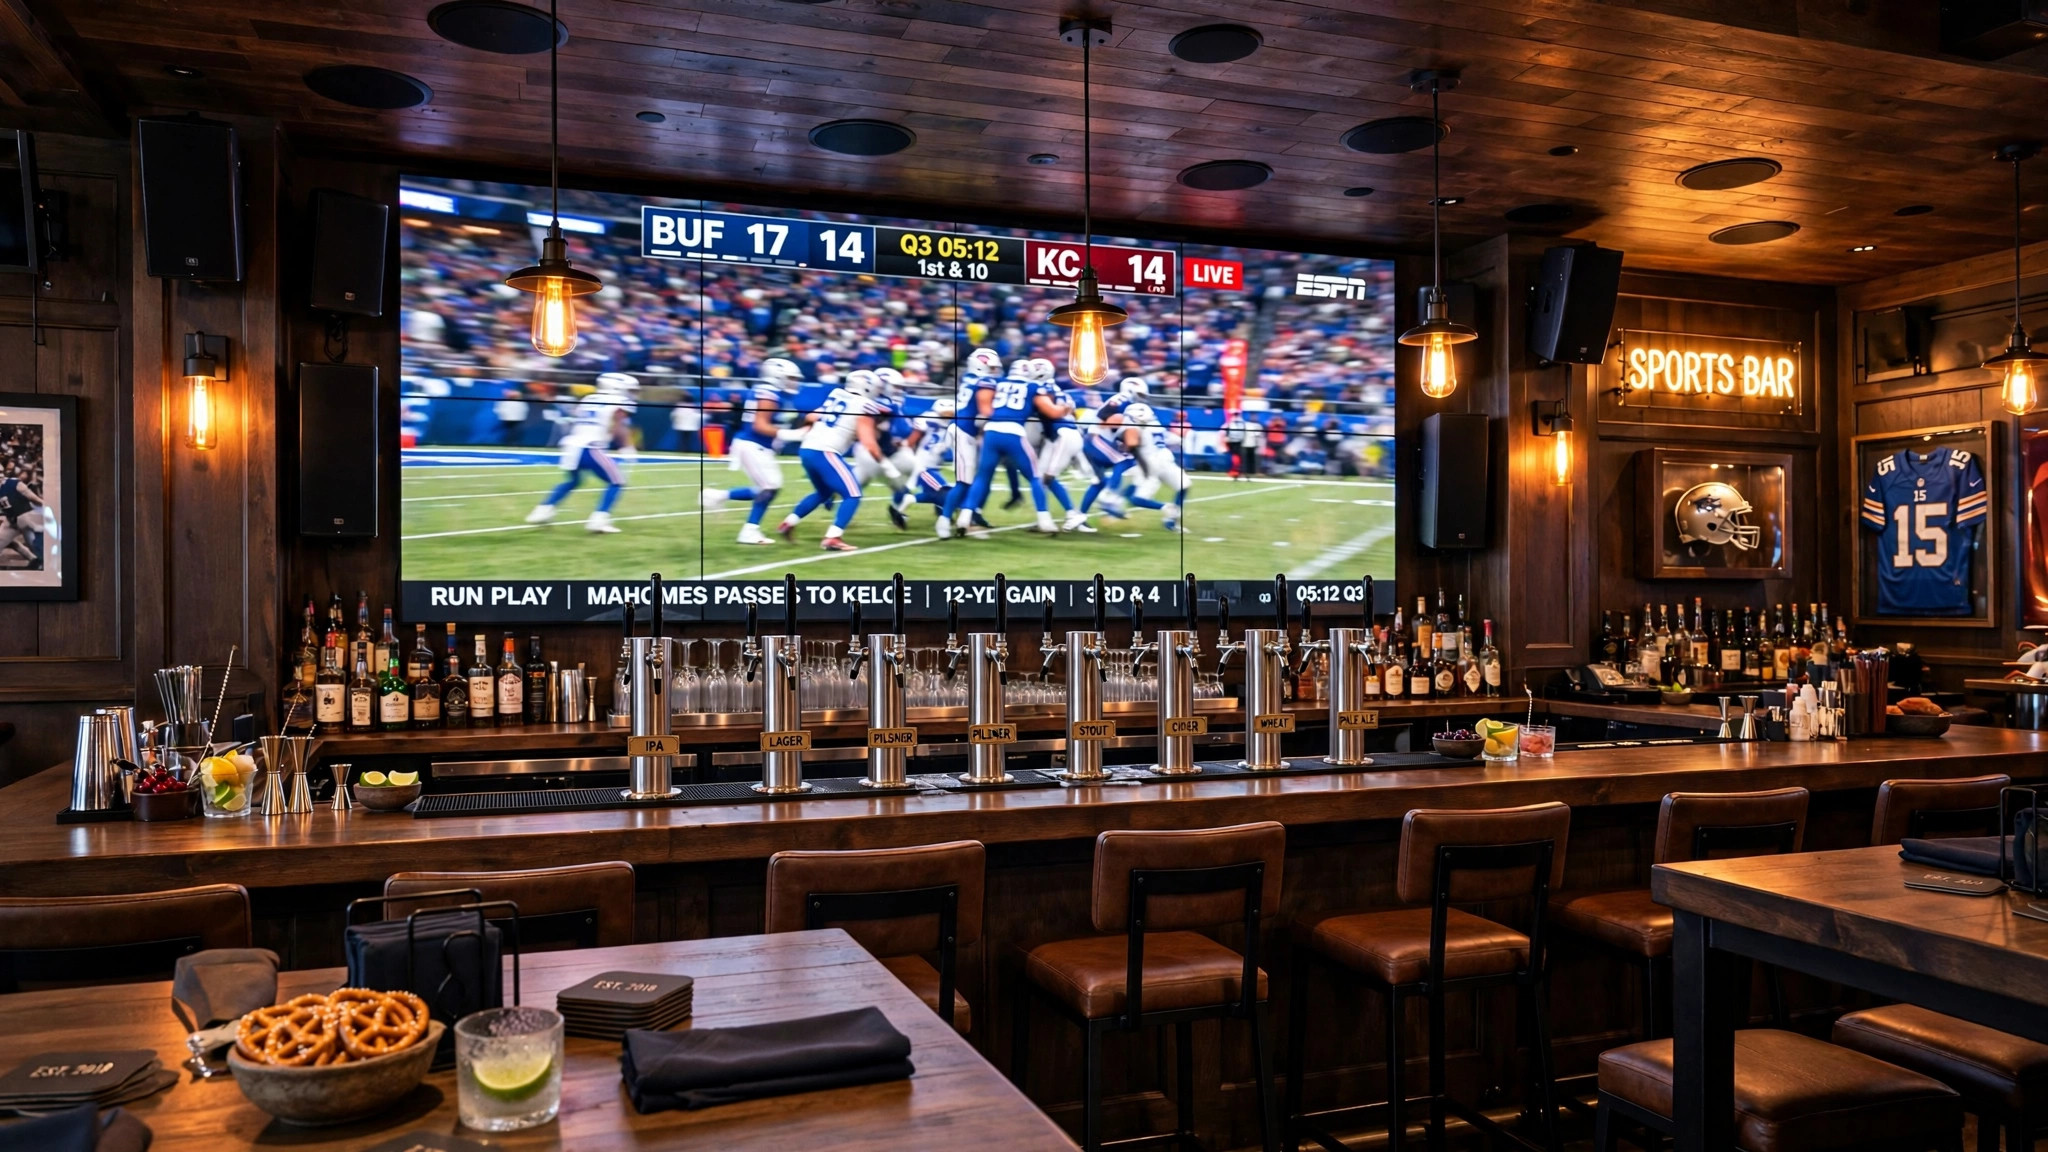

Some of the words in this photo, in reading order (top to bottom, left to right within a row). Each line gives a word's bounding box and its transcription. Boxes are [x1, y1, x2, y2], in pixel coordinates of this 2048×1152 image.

[651, 214, 725, 249] BUF
[747, 223, 789, 256] 17
[819, 229, 865, 264] 14
[900, 233, 932, 257] Q3
[938, 237, 1000, 262] 05:12
[917, 258, 945, 278] 1st
[949, 262, 963, 279] &
[967, 263, 989, 280] 10
[1037, 247, 1081, 278] KC
[1127, 254, 1167, 285] 14
[1193, 263, 1234, 285] LIVE
[1295, 272, 1366, 300] ESPN
[1629, 348, 1734, 394] SPORTS
[1743, 354, 1794, 398] BAR
[1877, 455, 1896, 476] 15
[1949, 449, 1972, 470] 15
[1913, 489, 1927, 502] 15
[1893, 502, 1948, 568] 15
[431, 586, 483, 606] RUN
[491, 586, 552, 606] PLAY
[806, 585, 836, 604] TO
[1006, 585, 1056, 604] GAIN
[1148, 585, 1160, 603] 4
[1296, 585, 1340, 602] 05:12
[1343, 585, 1364, 603] Q3
[1079, 725, 1110, 736] STOUT
[1172, 720, 1199, 733] CIDER
[1260, 717, 1289, 729] WHEAT
[645, 740, 664, 752] IPA
[769, 735, 803, 748] LAGER
[592, 980, 623, 990] EST.
[29, 1065, 70, 1078] EST.
